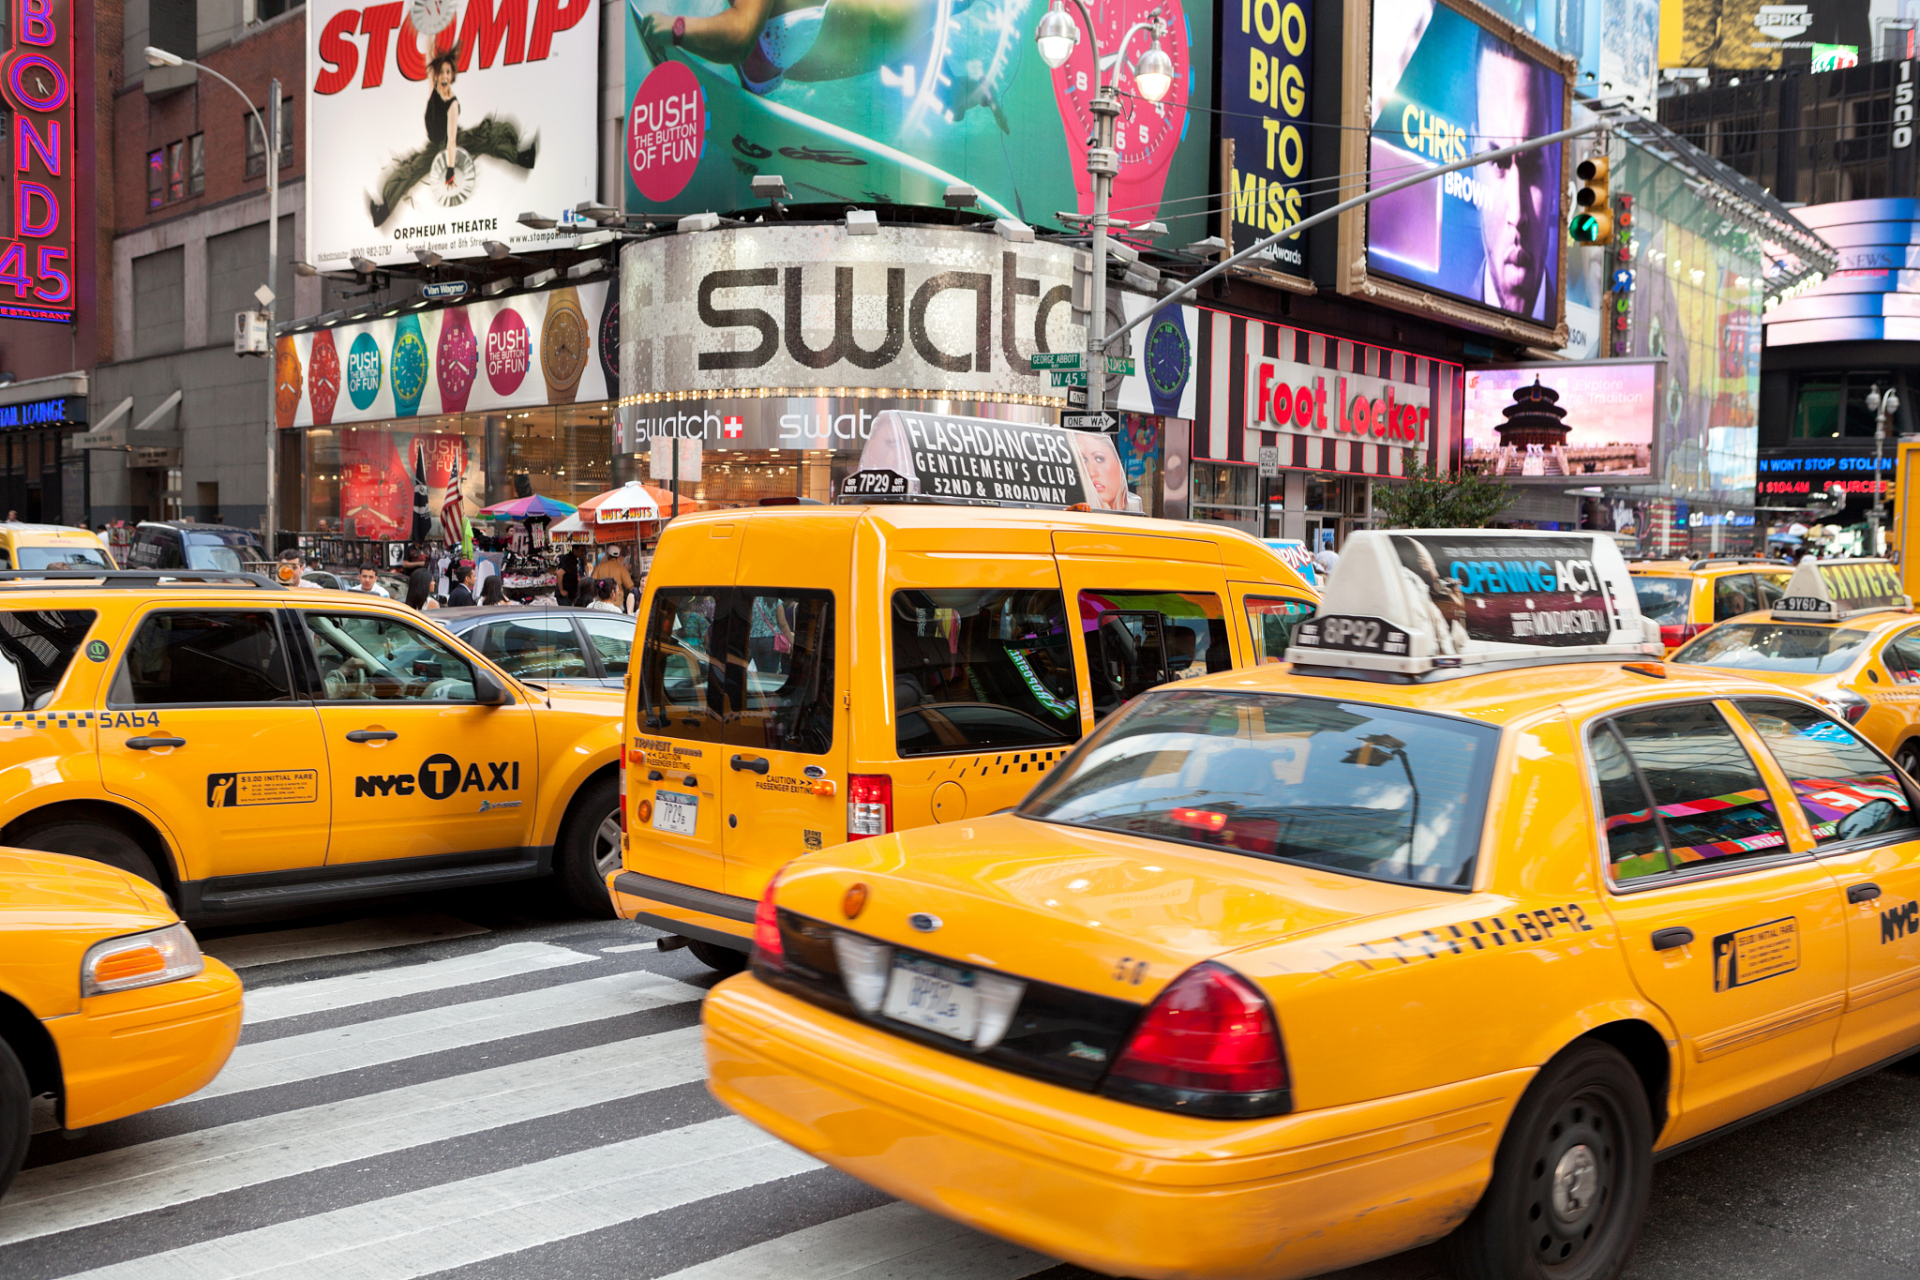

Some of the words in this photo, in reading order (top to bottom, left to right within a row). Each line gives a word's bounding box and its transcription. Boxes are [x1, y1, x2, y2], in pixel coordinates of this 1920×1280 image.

[1753, 13, 1814, 27] SPIKE
[314, 0, 592, 95] STOMP
[1249, 46, 1305, 118] BIG
[634, 90, 697, 136] PUSH
[1892, 61, 1914, 149] 1500
[8, 0, 69, 237] BOND
[634, 133, 653, 149] THE
[656, 122, 697, 145] BUTTON
[1116, 131, 1126, 150] 6
[1402, 104, 1467, 164] CHRIS
[633, 146, 657, 171] OF
[662, 136, 697, 166] FUN
[1263, 115, 1304, 179] TO
[1444, 171, 1494, 211] BROWN
[1231, 168, 1302, 240] MISS
[394, 223, 447, 240] ORPHEUM
[451, 218, 498, 234] THEATRE
[1619, 196, 1633, 261] TOYS
[405, 242, 426, 254] Second
[427, 240, 448, 251] Avenue
[450, 241, 457, 250] at
[458, 238, 468, 248] 8th
[1845, 253, 1894, 267] NEWS
[0, 242, 70, 303] 45
[428, 286, 440, 295] Van
[440, 283, 465, 296] Wagner
[488, 328, 526, 352] PUSH
[350, 350, 379, 373] PUSH
[489, 351, 500, 361] THE
[501, 350, 526, 360] BUTTON
[1033, 355, 1055, 365] GEORGE
[1056, 354, 1078, 364] ABBOTT
[350, 371, 359, 380] THE
[359, 368, 379, 379] BUTTON
[488, 363, 503, 376] OF
[504, 359, 526, 374] FUN
[1109, 358, 1127, 373] TIMES
[350, 379, 361, 392] OF
[362, 377, 379, 391] FUN
[1051, 372, 1062, 386] W
[1064, 372, 1078, 386] 45
[1575, 379, 1624, 393] Explore
[1072, 392, 1085, 403] ONE
[1256, 362, 1328, 430] Foot
[1334, 375, 1430, 443] Locker
[1588, 391, 1643, 405] Tradition
[22, 400, 65, 425] LOUNGE
[1068, 417, 1084, 426] ONE
[1090, 417, 1110, 426] WAY
[635, 410, 721, 443] swatch
[414, 438, 462, 455] PUSH
[905, 417, 1073, 465] FLASHDANCERS
[431, 453, 462, 461] BUTTO
[1770, 459, 1803, 472] WON'T
[1804, 458, 1836, 471] STOP
[1838, 457, 1892, 471] STOLEN
[915, 452, 1031, 481] GENTLEMEN'S
[1037, 465, 1076, 487] CLUB
[845, 485, 858, 493] DUTY
[847, 478, 857, 486] OFF
[859, 473, 890, 493] 7P29
[891, 485, 905, 493] DUTY
[894, 477, 904, 486] OFF
[934, 476, 972, 496] 52ND
[975, 483, 987, 497] &
[994, 481, 1067, 504] BROADWAY
[601, 506, 652, 521] NUTS4NUTS
[551, 531, 589, 544] NUTS4NUTS
[1450, 560, 1557, 594] OPENING
[1554, 560, 1599, 592] ACT
[1819, 563, 1903, 600] SAVAGES
[1788, 597, 1817, 611] 9Y60
[1323, 617, 1381, 648] 8P92
[633, 736, 672, 753] TRANSIT
[264, 774, 292, 782] INITIAL
[355, 774, 416, 798] NYC
[424, 757, 520, 797] TAXI
[755, 781, 790, 793] PASSENGER
[766, 775, 797, 786] CAUTION
[1515, 903, 1594, 942] 8P92
[1879, 900, 1920, 945] NYC
